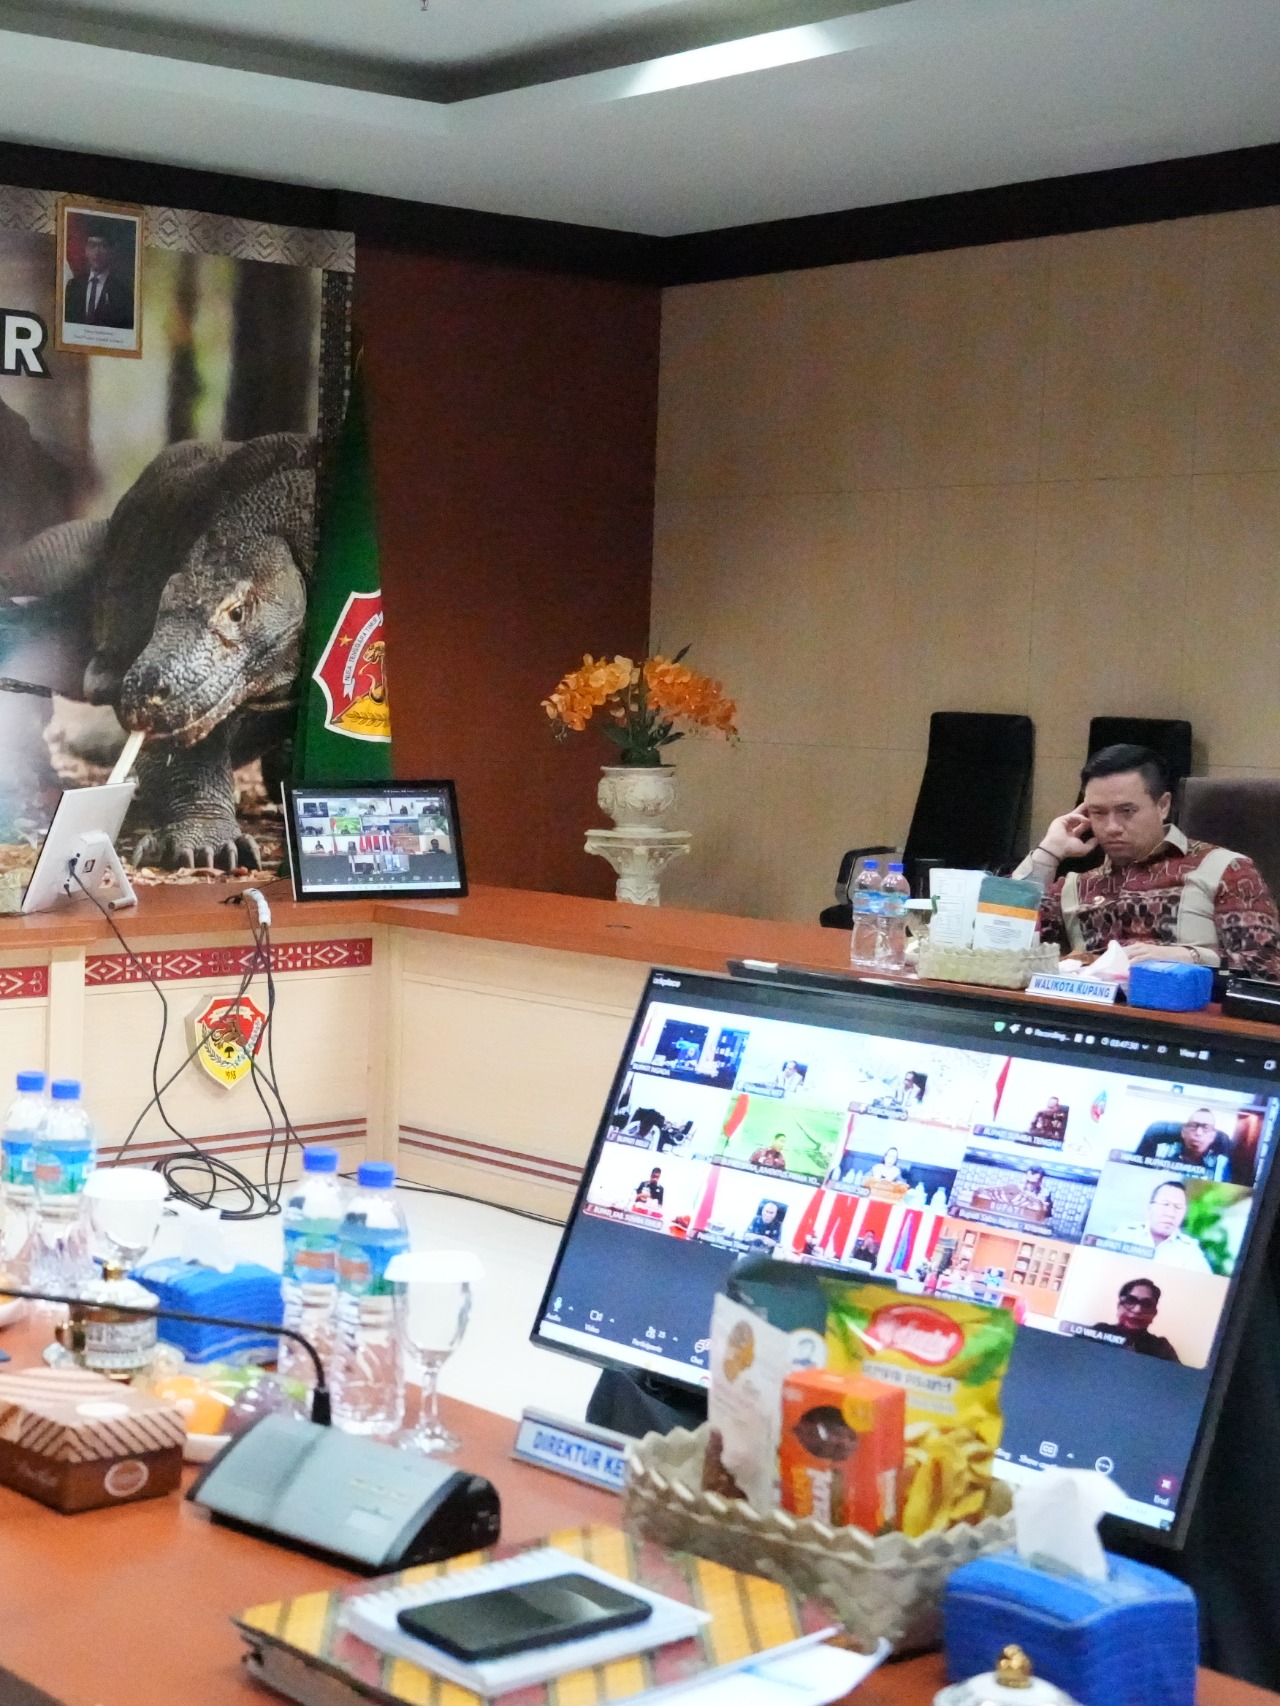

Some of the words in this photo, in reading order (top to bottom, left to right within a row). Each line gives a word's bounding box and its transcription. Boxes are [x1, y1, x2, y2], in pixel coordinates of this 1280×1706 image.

[1034, 978, 1075, 992] WALIKOTA
[1076, 983, 1110, 998] KUPANG
[532, 1431, 602, 1471] DIREKTUR
[1153, 1494, 1170, 1507] End
